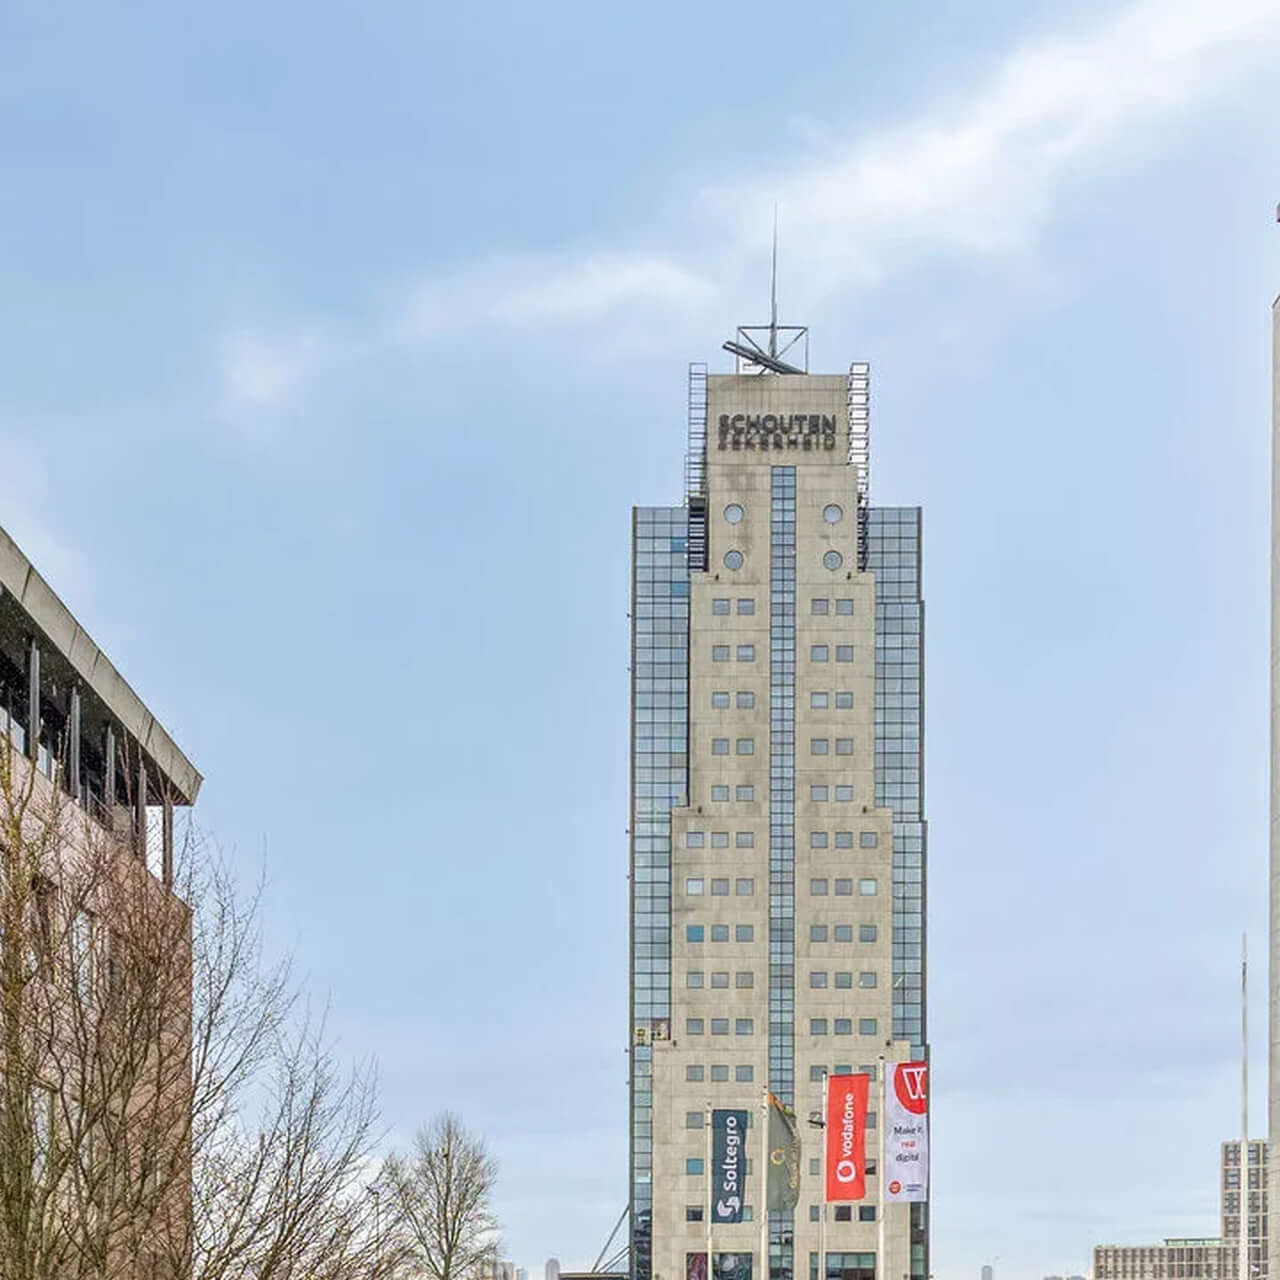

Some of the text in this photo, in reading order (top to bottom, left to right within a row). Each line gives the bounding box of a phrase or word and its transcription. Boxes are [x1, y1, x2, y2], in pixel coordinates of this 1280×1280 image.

[718, 414, 836, 434] SCHOUTEN
[722, 1116, 740, 1191] Soltegro
[841, 1093, 854, 1158] vodafone
